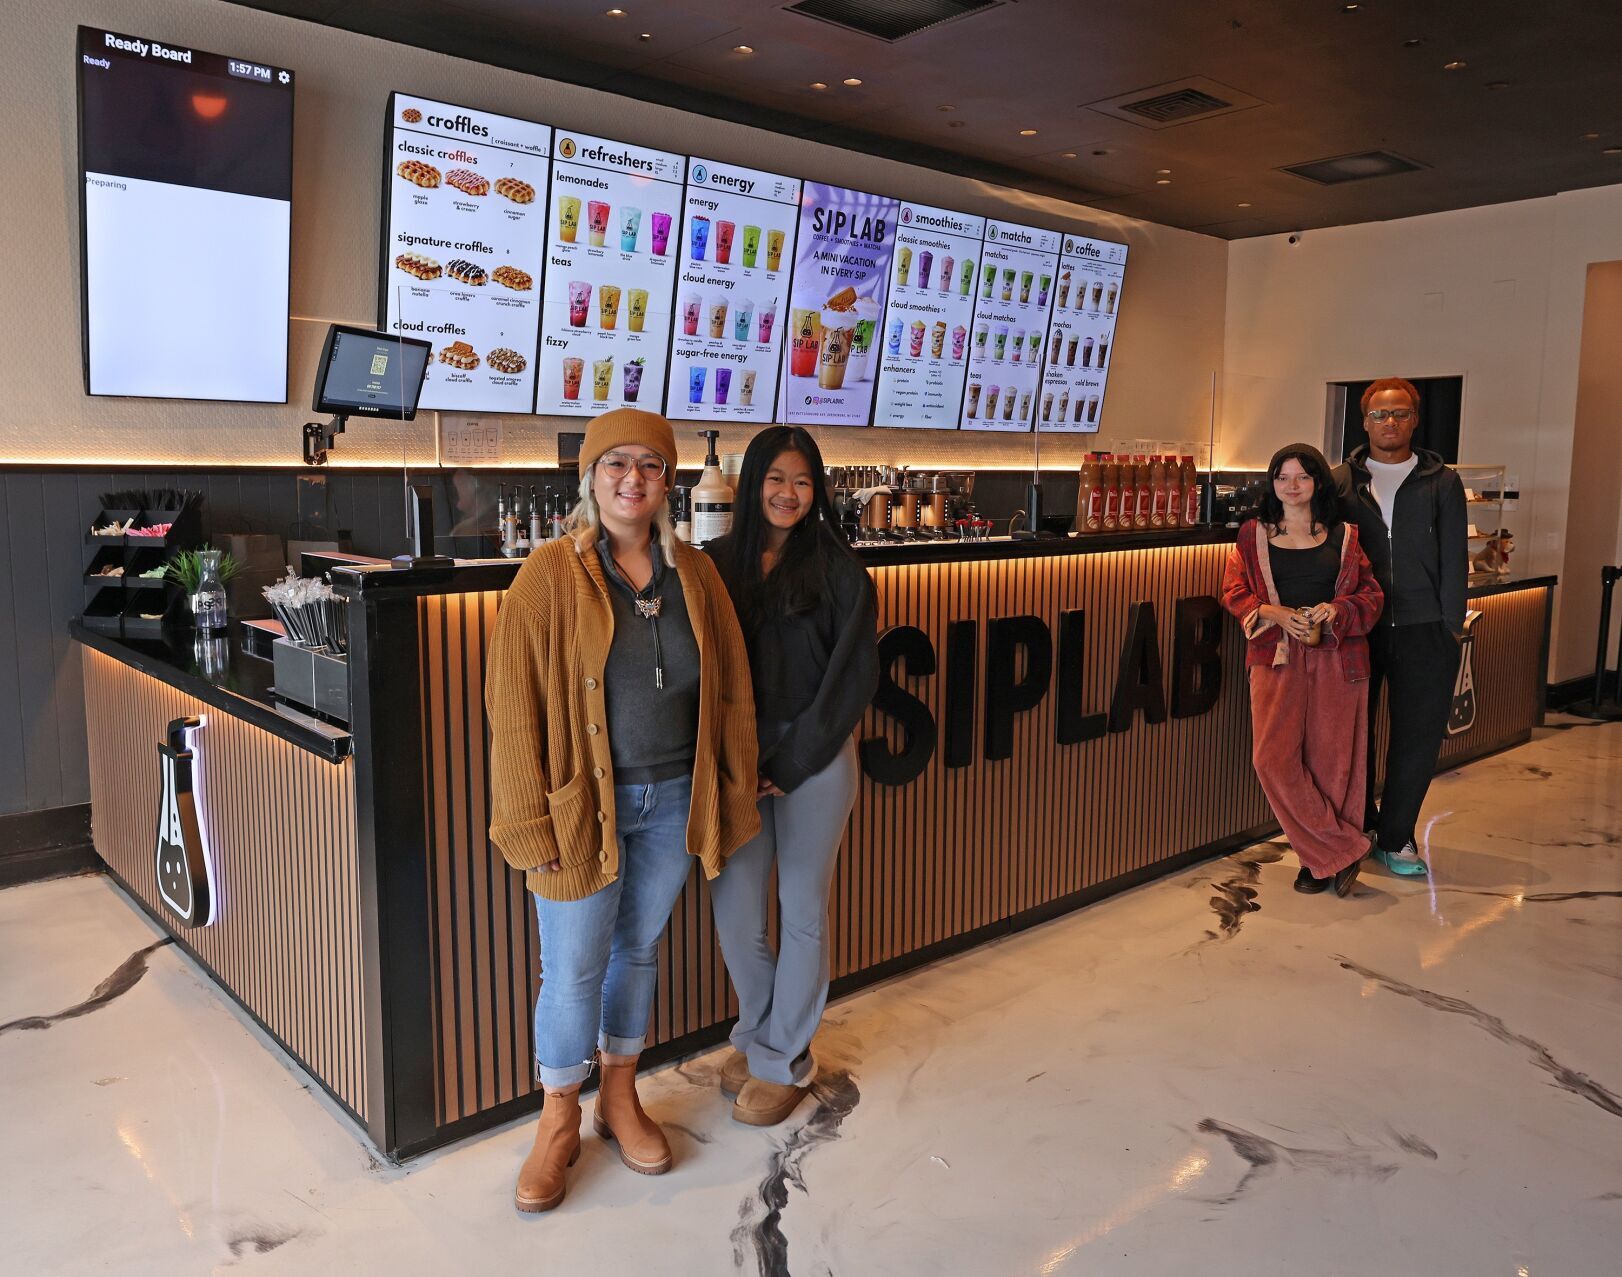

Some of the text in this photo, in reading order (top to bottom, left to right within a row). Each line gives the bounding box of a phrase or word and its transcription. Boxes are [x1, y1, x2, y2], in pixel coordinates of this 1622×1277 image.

[105, 33, 192, 64] Ready Board
[83, 55, 111, 70] Ready
[229, 62, 271, 79] 1:57 PM
[427, 115, 489, 137] croffles
[398, 141, 478, 165] classic croffles
[582, 146, 653, 171] refreshers
[86, 176, 127, 191] Preparing
[556, 170, 609, 189] lemonades
[712, 173, 755, 193] energy
[453, 200, 480, 210] strawberry
[689, 197, 719, 211] energy
[812, 207, 886, 243] SIP LAB
[916, 214, 963, 231] smoothies
[398, 232, 494, 254] signature croffles
[813, 234, 829, 242] COFFEE
[898, 234, 950, 250] classic smoothies
[1001, 231, 1032, 244] matcha
[985, 251, 1008, 260] matchas
[1076, 243, 1100, 258] coffee
[551, 256, 572, 267] teas
[813, 251, 876, 268] A MINI VACATION
[1062, 262, 1075, 271] lattes
[821, 266, 866, 280] IN EVERY SIP
[683, 272, 735, 289] cloud energy
[891, 300, 940, 313] cloud smoothies
[977, 311, 1016, 323] cloud matchas
[426, 323, 466, 335] croffles
[1053, 321, 1072, 329] mochas
[546, 336, 569, 349] fizzy
[793, 338, 819, 350] SIP LAB
[856, 345, 868, 354] LAB
[676, 348, 748, 363] sugar-free energy
[822, 353, 846, 364] SIP LAB
[884, 365, 915, 374] enhancers
